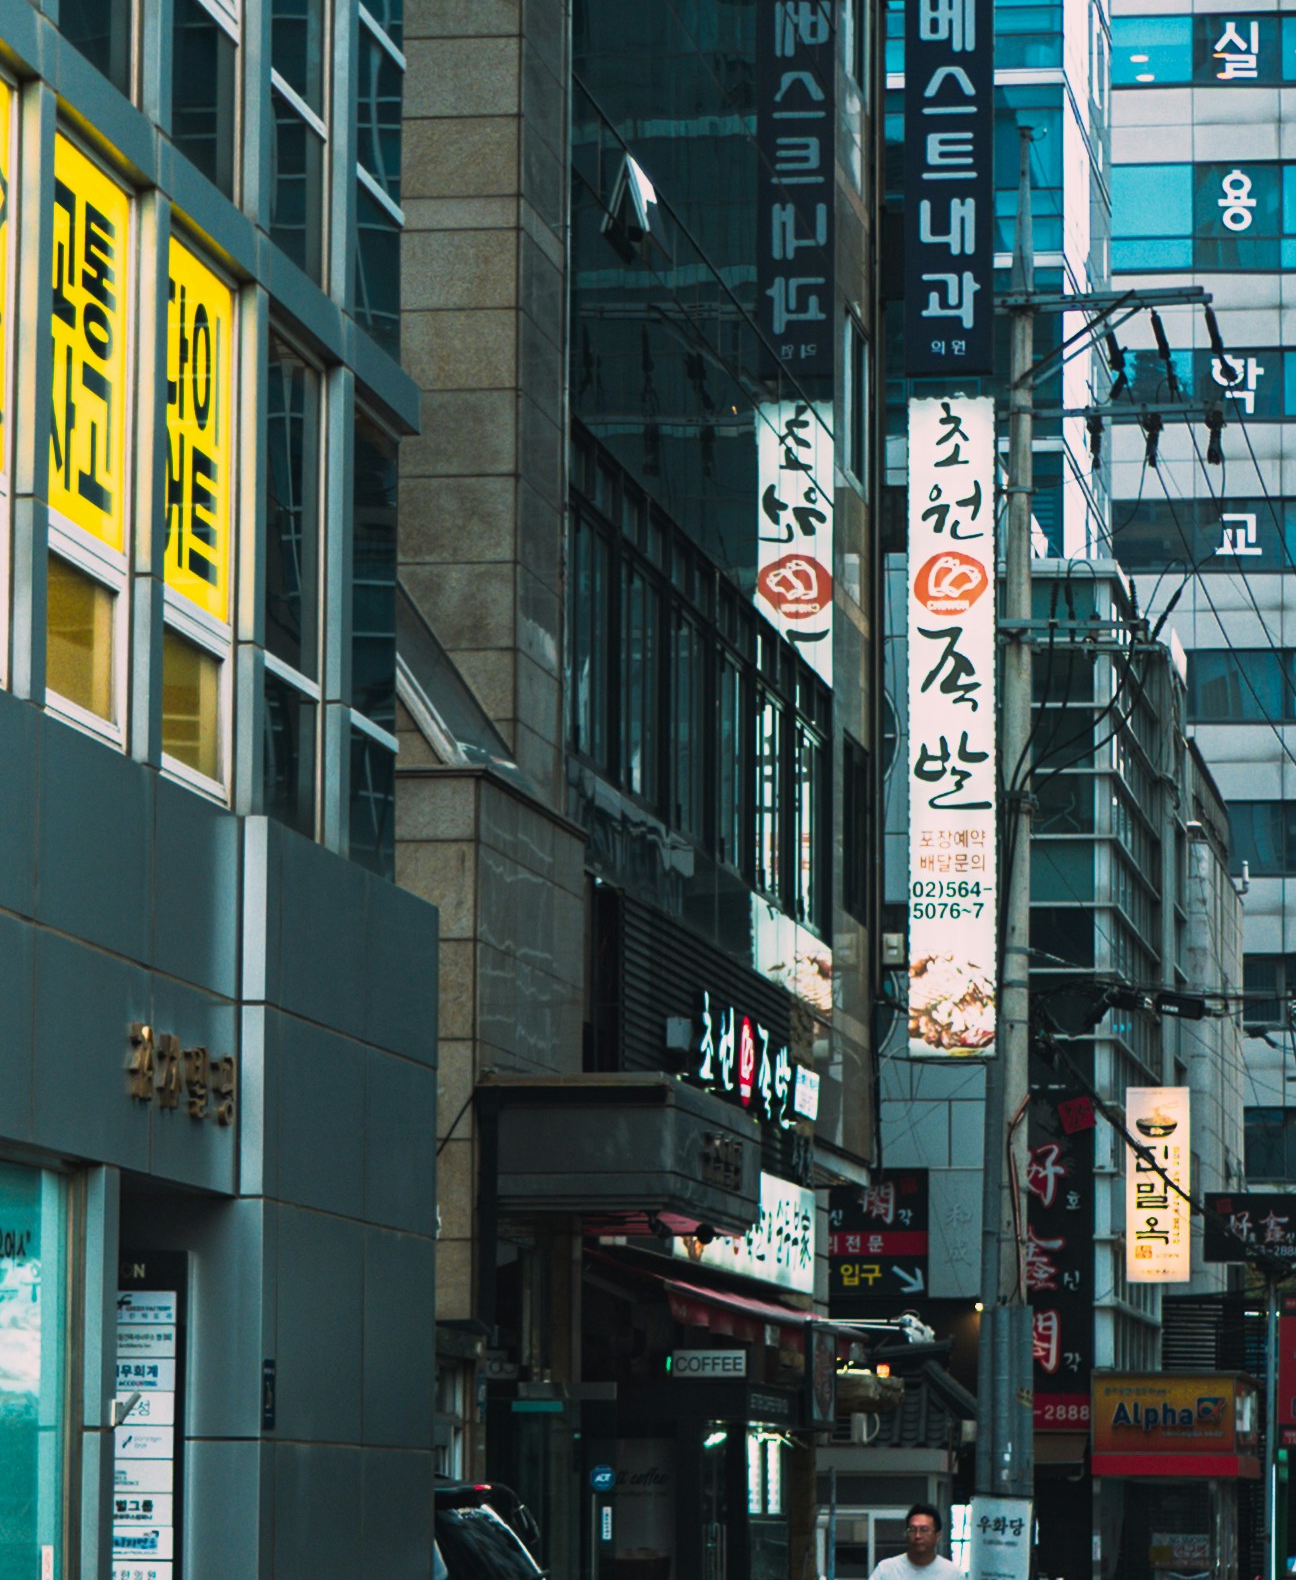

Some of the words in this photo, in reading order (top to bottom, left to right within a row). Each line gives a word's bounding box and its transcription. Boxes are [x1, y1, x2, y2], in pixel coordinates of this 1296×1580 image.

[930, 339, 968, 356] 의원
[920, 401, 983, 541] 초원
[914, 624, 993, 811] 족발
[919, 828, 987, 849] 포장예약
[919, 852, 987, 873] 배달문의
[912, 880, 993, 903] 02)564-
[840, 1264, 882, 1286] 입구
[675, 1356, 743, 1372] COFFEE
[1112, 1402, 1194, 1432] Alpha
